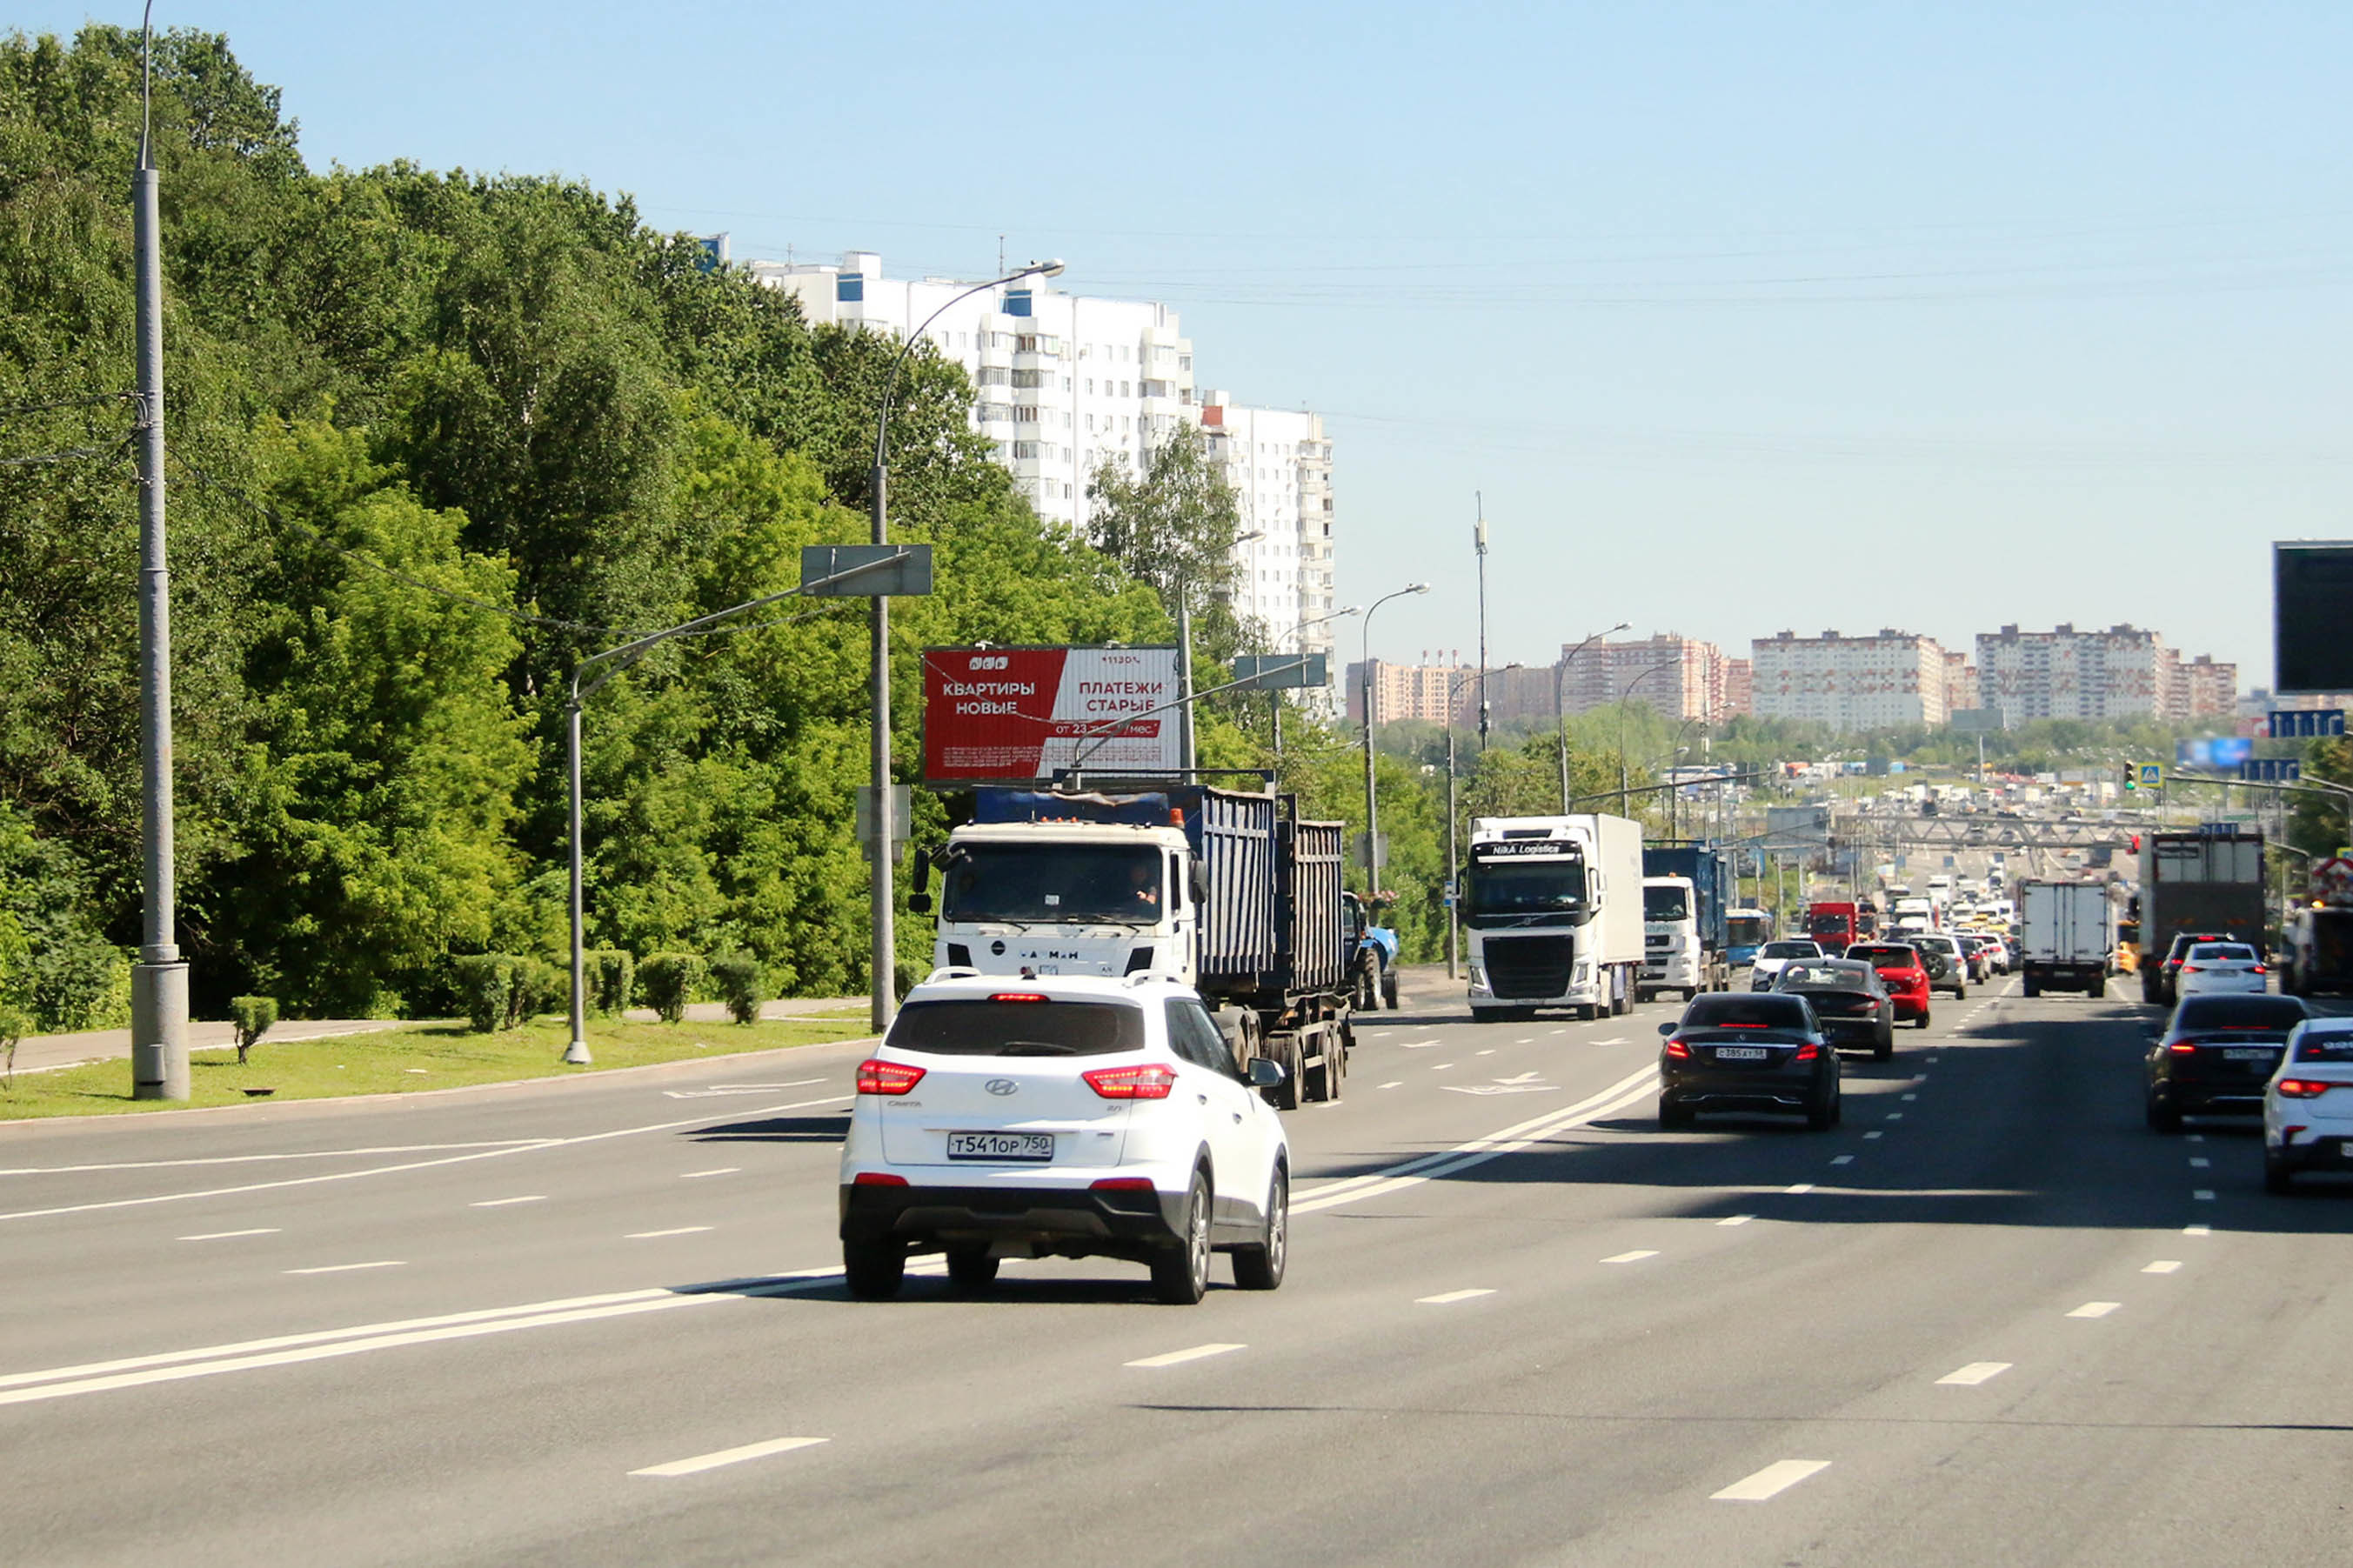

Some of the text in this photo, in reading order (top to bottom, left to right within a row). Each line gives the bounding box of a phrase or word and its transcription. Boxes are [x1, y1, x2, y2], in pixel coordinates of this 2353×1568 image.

[943, 683, 1035, 696] КВАРТИРЫ
[1080, 682, 1162, 694] ПЛАТЕЖИ
[956, 702, 1018, 714] НОВЫЕ
[1086, 699, 1155, 711] СТАРЫЕ
[1056, 725, 1070, 734] от
[1073, 724, 1087, 734] 23
[955, 1136, 1019, 1154] Т541ОР
